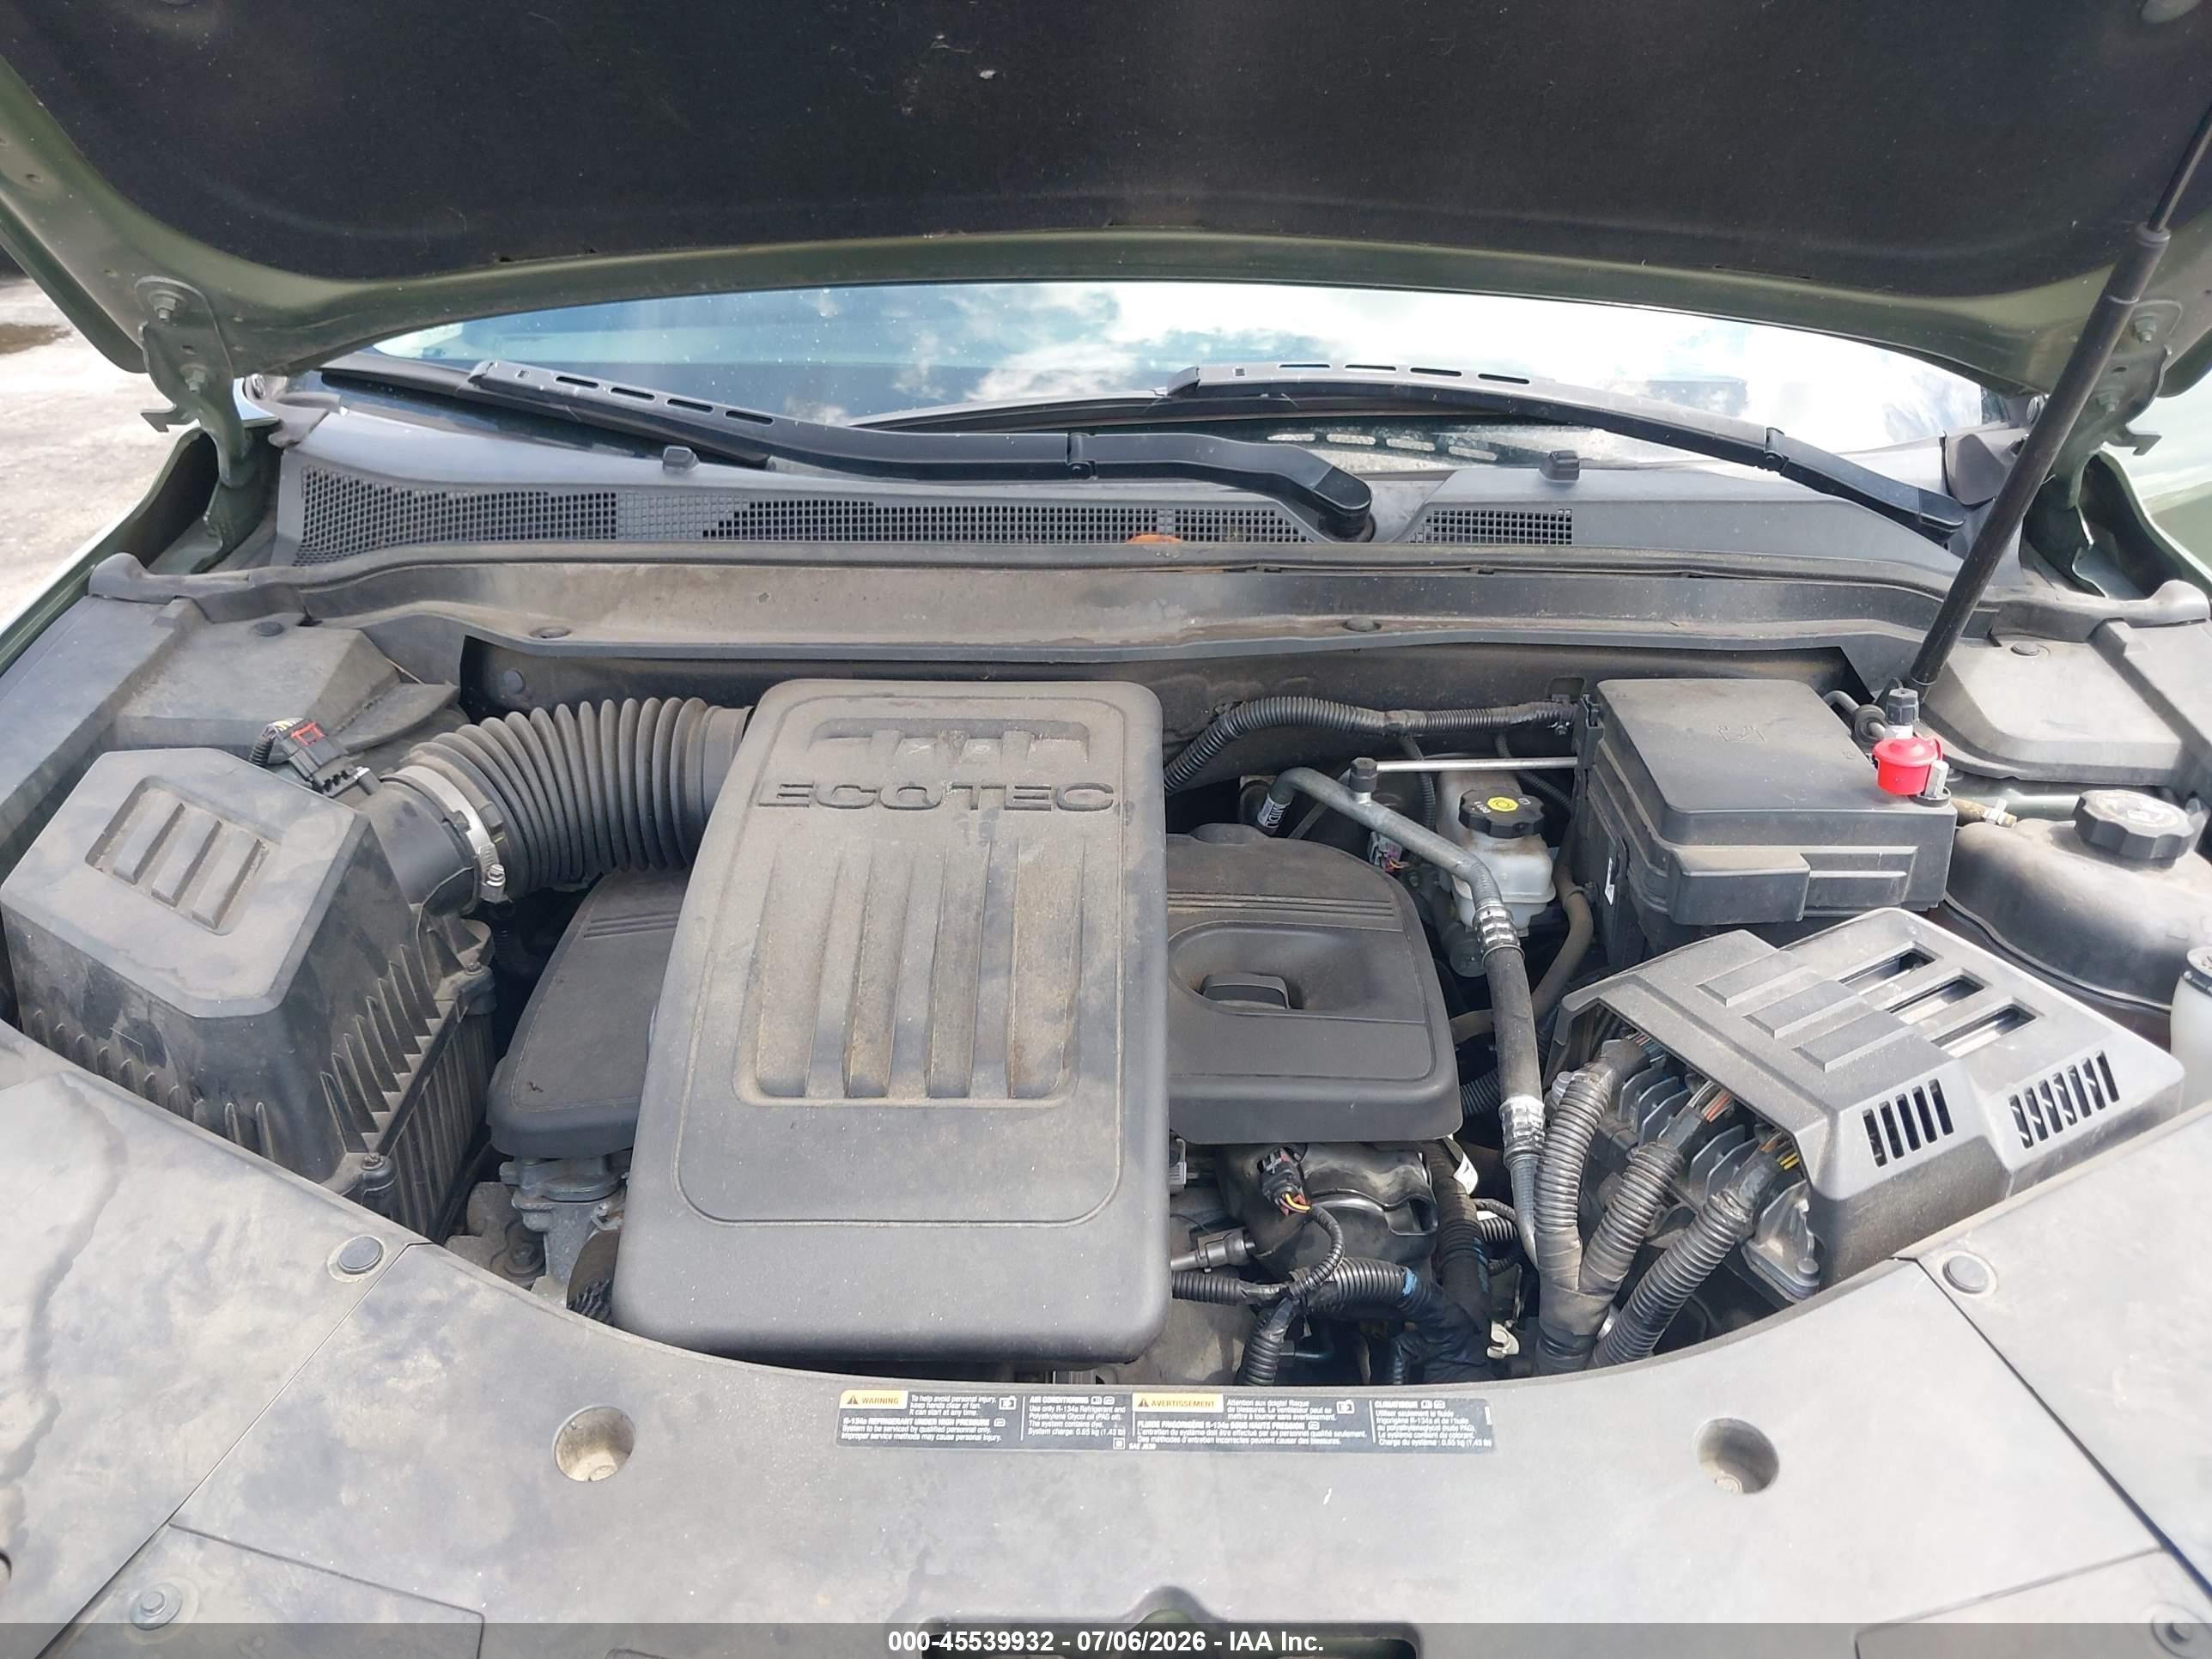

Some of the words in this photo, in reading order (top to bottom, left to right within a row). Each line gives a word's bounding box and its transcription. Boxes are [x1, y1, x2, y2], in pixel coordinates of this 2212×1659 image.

[757, 781, 1115, 811] ECOTEC
[861, 1396, 899, 1405] WARNING
[1152, 1400, 1214, 1408] AVERTISSEMENT
[910, 1425, 918, 1434] by
[1091, 1421, 1104, 1430] dye.
